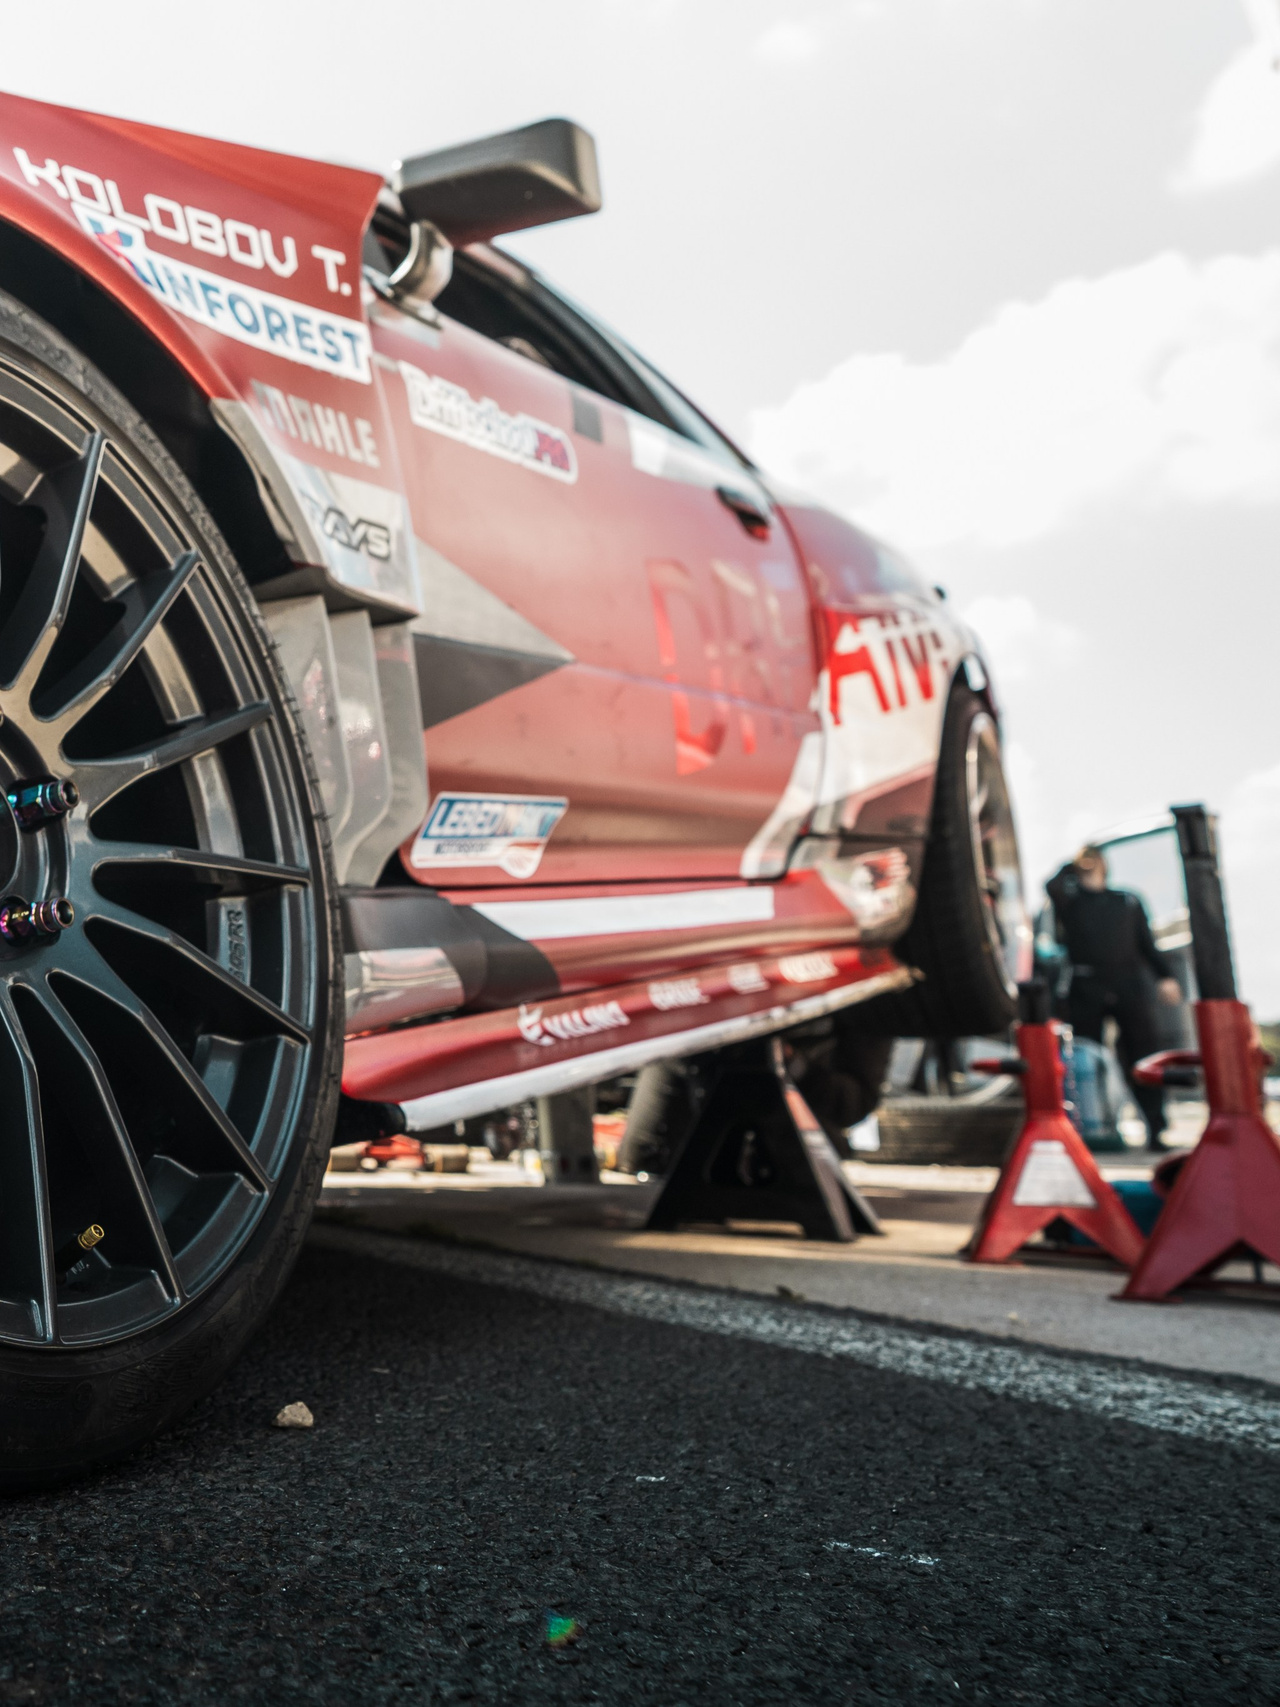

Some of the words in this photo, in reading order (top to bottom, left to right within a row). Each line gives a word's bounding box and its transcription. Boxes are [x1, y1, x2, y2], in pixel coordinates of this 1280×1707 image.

[13, 147, 299, 279] KOLOBOV
[311, 244, 353, 296] T.
[251, 379, 381, 469] MAHLE
